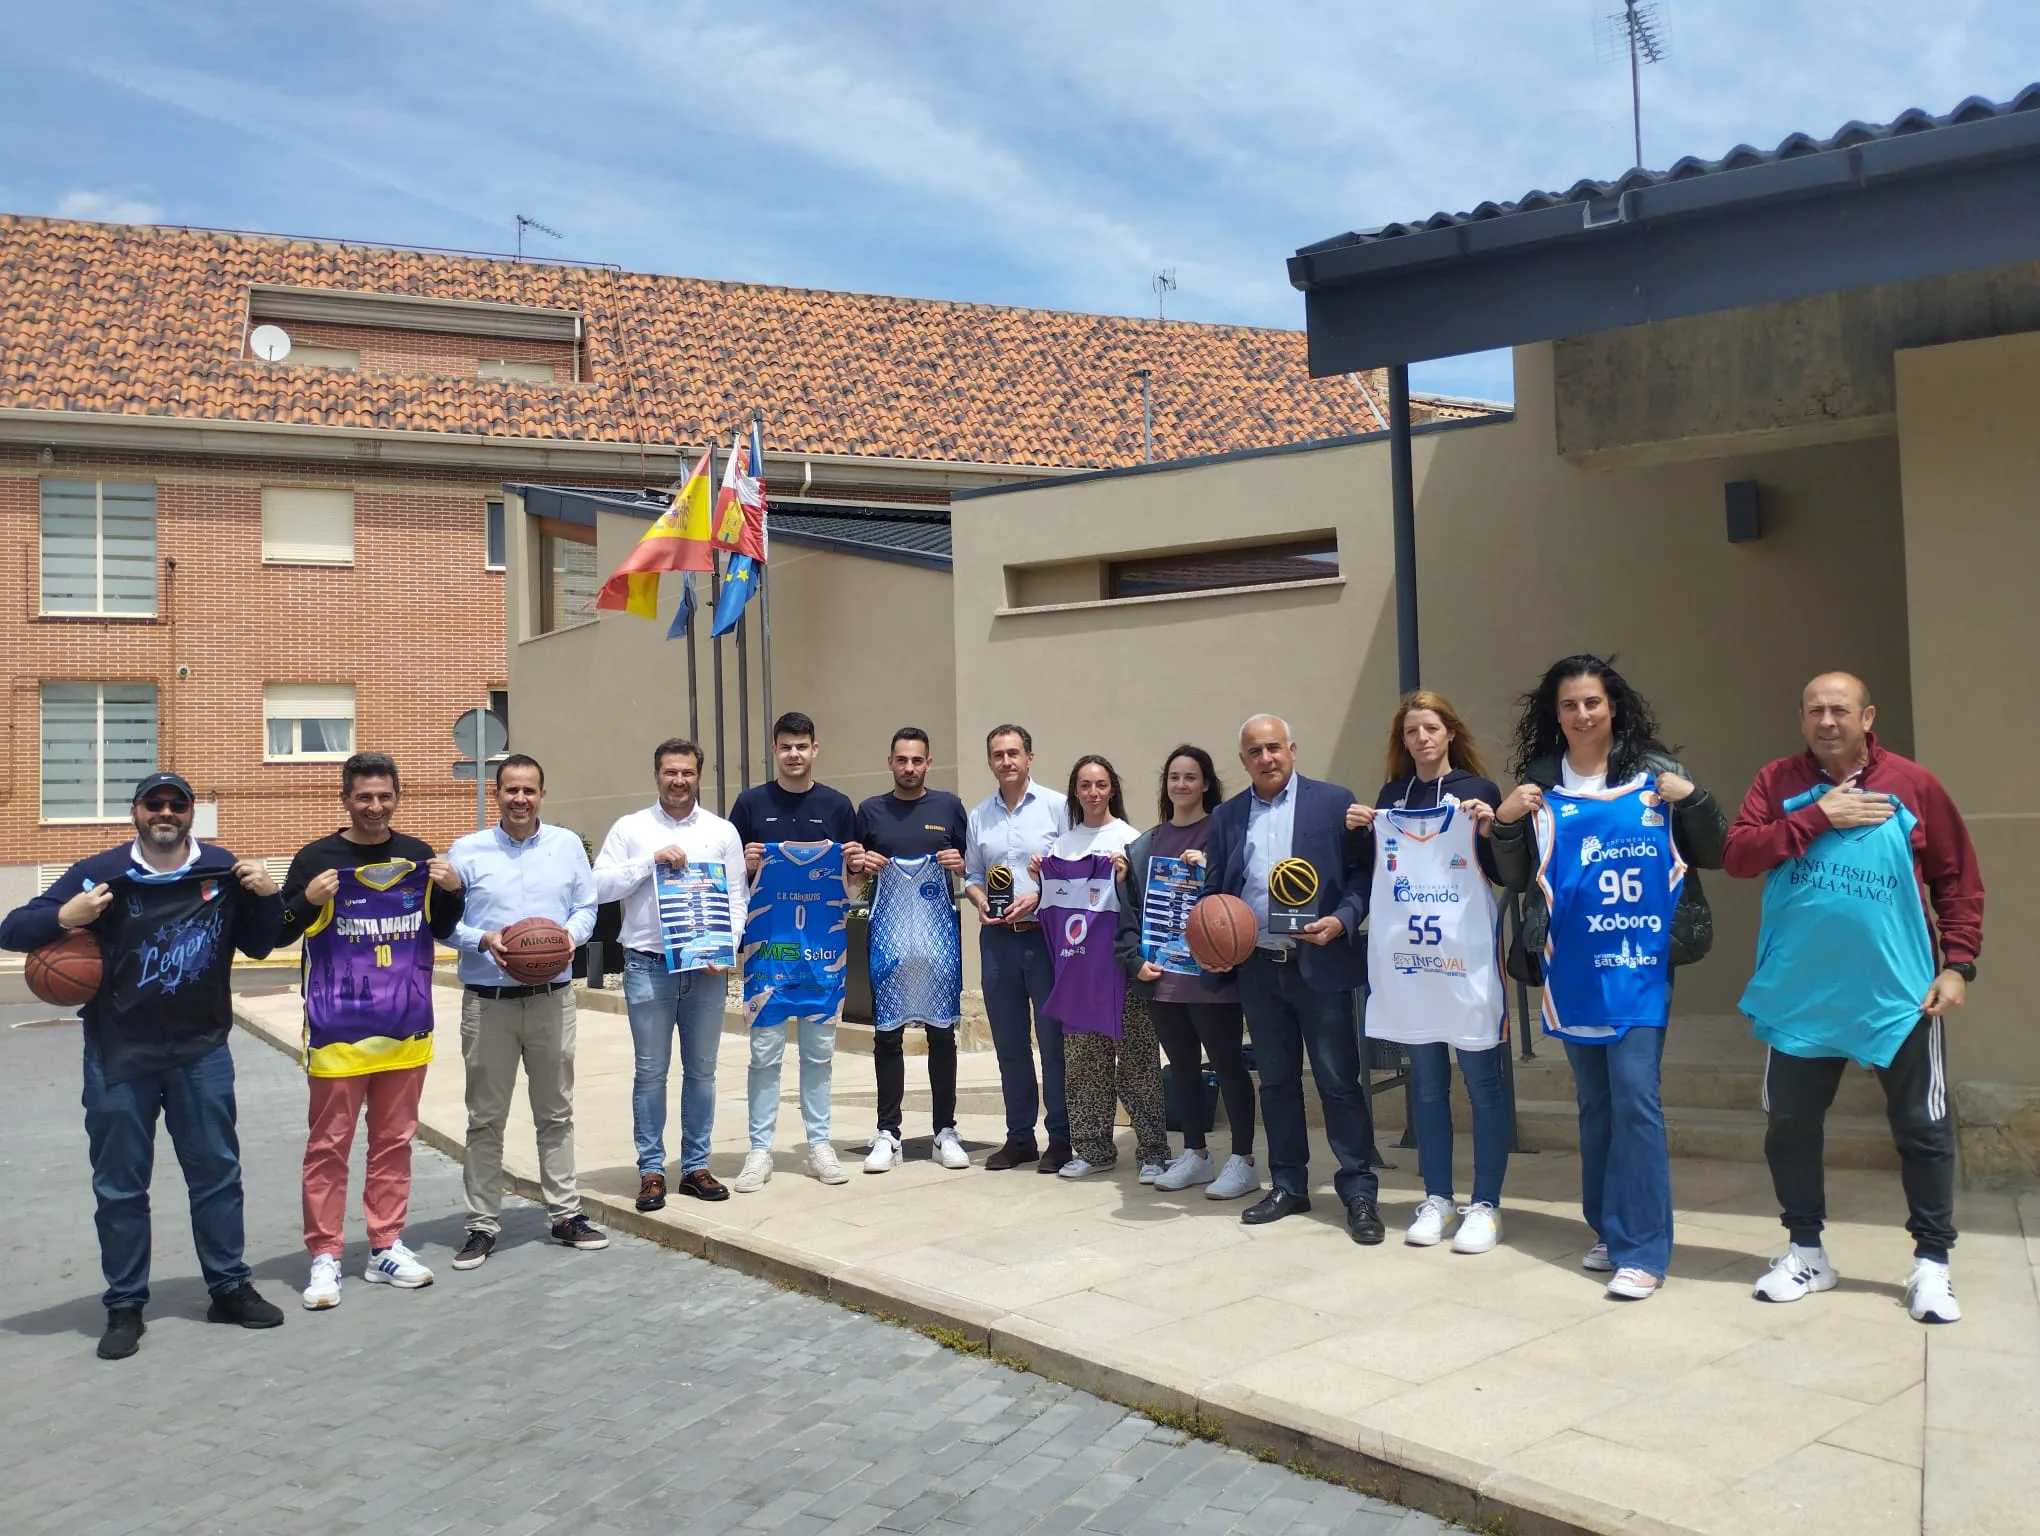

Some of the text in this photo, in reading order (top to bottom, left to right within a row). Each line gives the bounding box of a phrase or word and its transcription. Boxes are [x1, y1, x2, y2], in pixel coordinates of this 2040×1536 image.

[1599, 868, 1643, 905] 96
[336, 916, 380, 936] SANTA
[795, 904, 806, 930] 0
[1586, 913, 1662, 933] Xoborg
[349, 935, 361, 943] DE
[1408, 915, 1442, 945] 55
[137, 908, 224, 988] Legends
[374, 944, 393, 967] 10
[804, 948, 837, 961] Solar
[1412, 954, 1467, 972] INFOVAL
